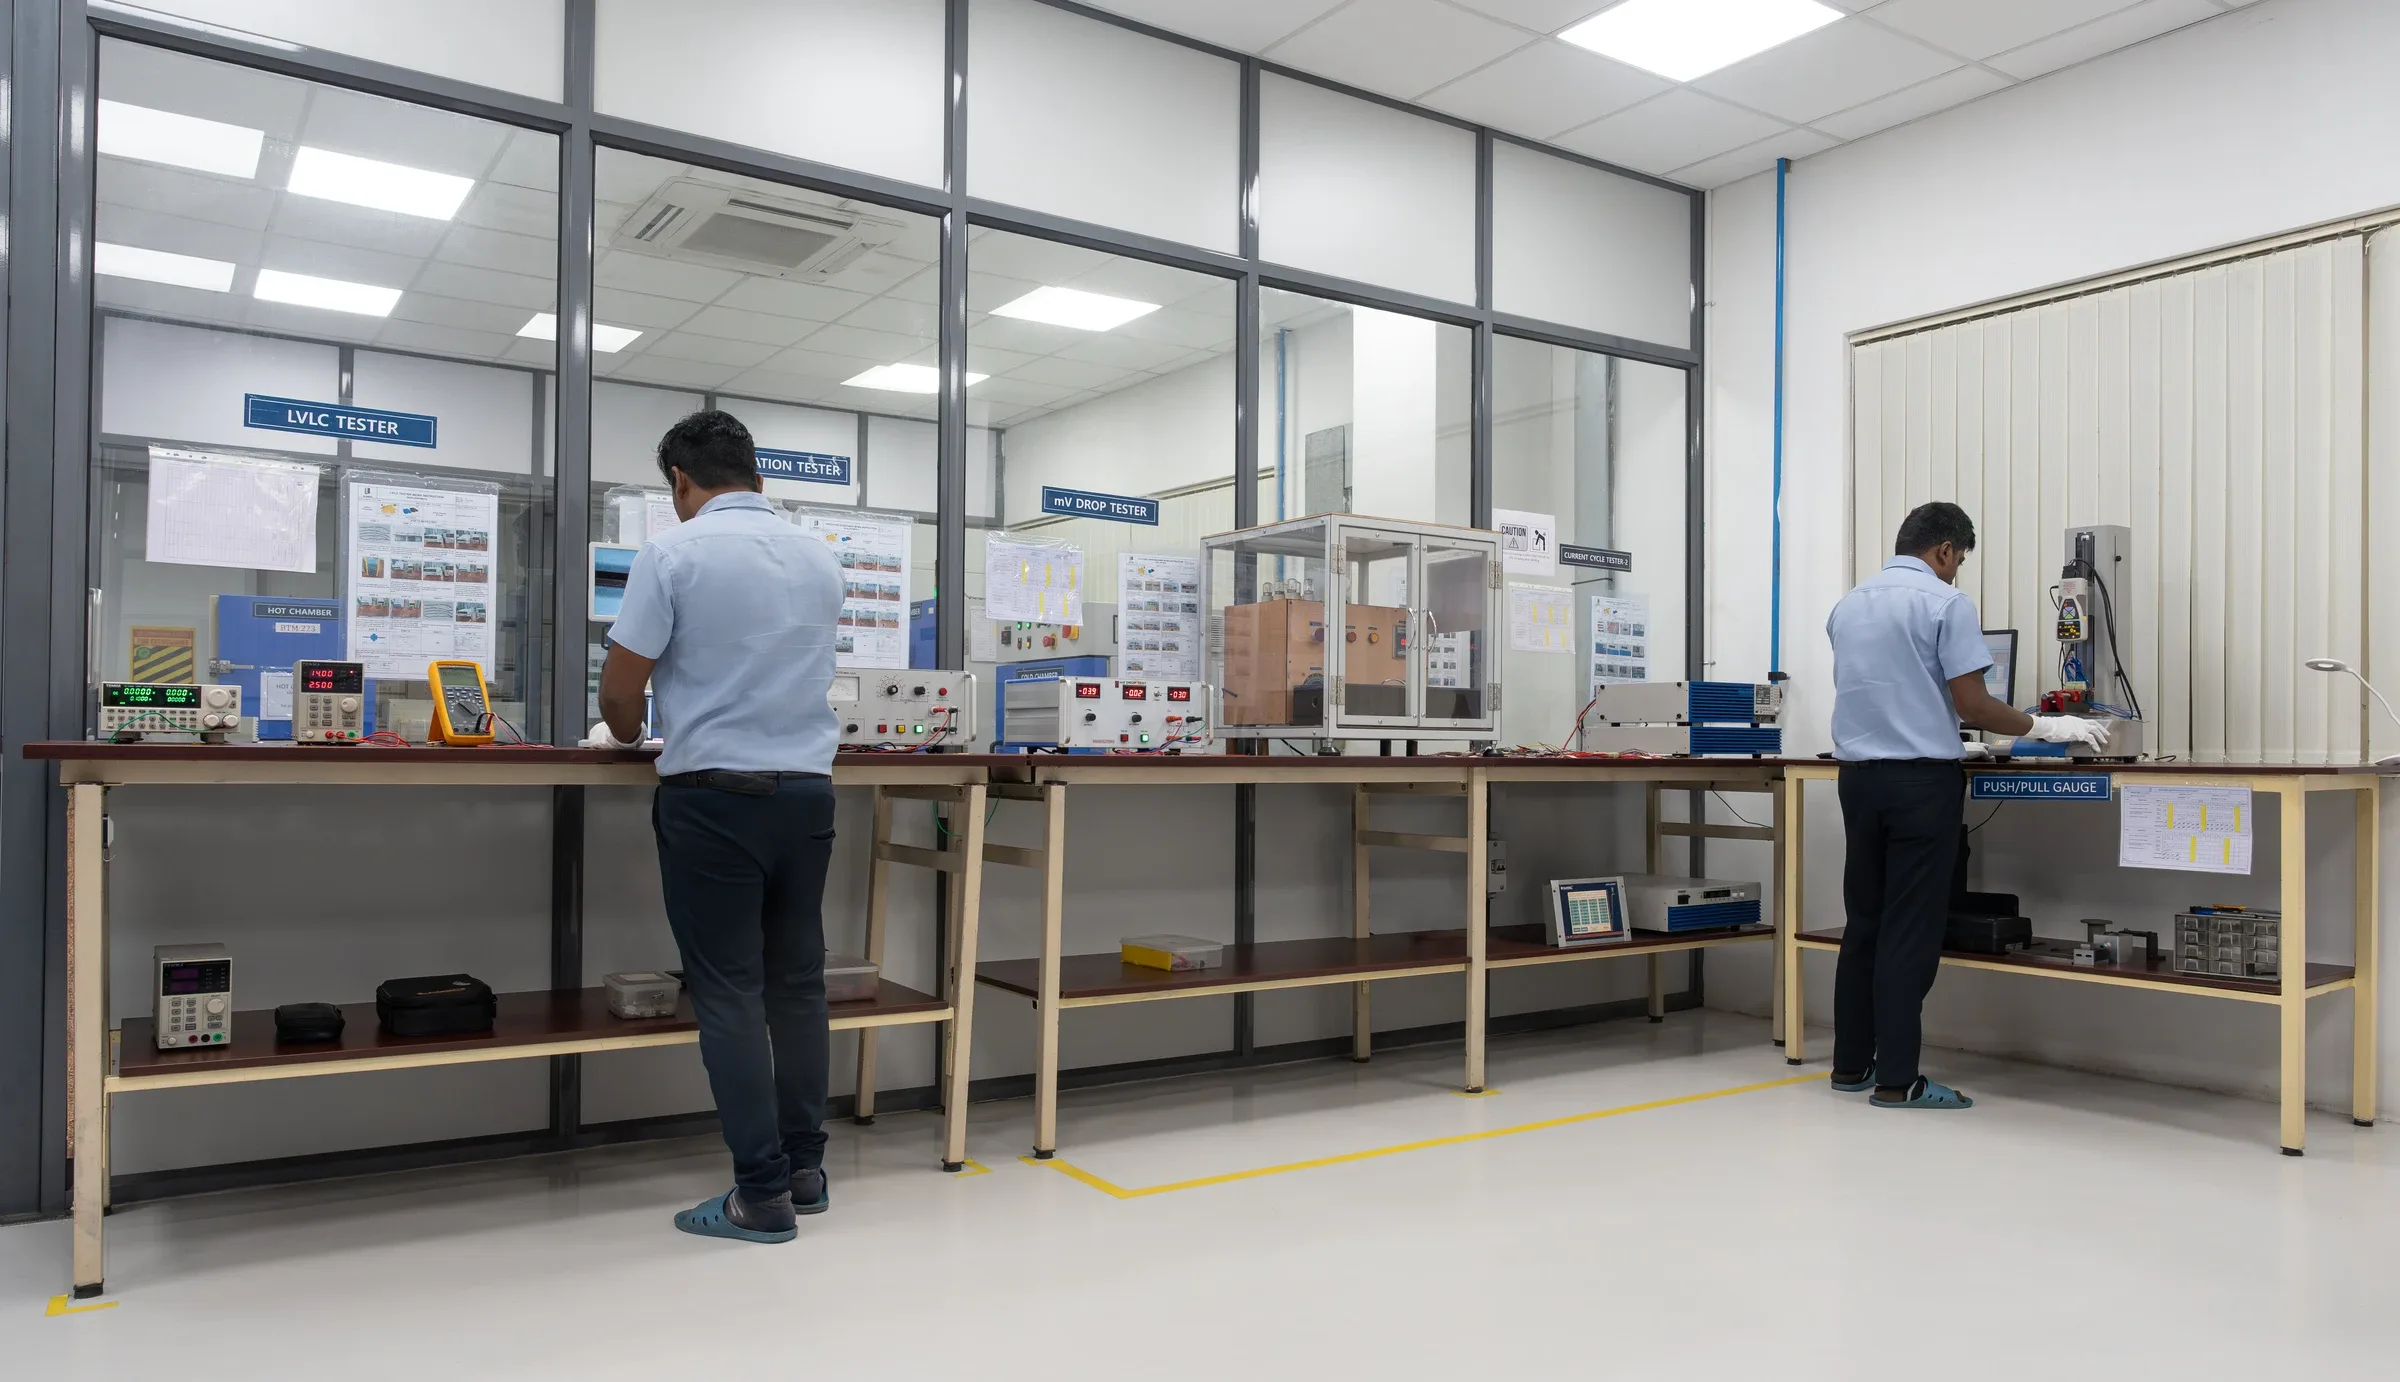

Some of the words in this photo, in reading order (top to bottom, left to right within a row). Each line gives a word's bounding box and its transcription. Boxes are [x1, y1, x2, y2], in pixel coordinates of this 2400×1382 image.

[287, 409, 329, 427] LVLC
[336, 415, 399, 435] TESTER
[755, 457, 792, 471] ATION
[796, 461, 841, 476] TESTER
[1054, 497, 1073, 508] mV
[1076, 498, 1106, 511] DROP
[1110, 502, 1147, 516] TESTER
[1501, 526, 1526, 537] CAUTION
[1564, 552, 1588, 560] CURRENT
[1590, 554, 1605, 563] CYCLE
[1606, 556, 1628, 566] TESTER-2
[268, 607, 286, 615] HOT
[289, 608, 332, 616] CHAMBER
[1983, 780, 2050, 794] PUSH/PULL
[2053, 782, 2097, 793] GAUGE
